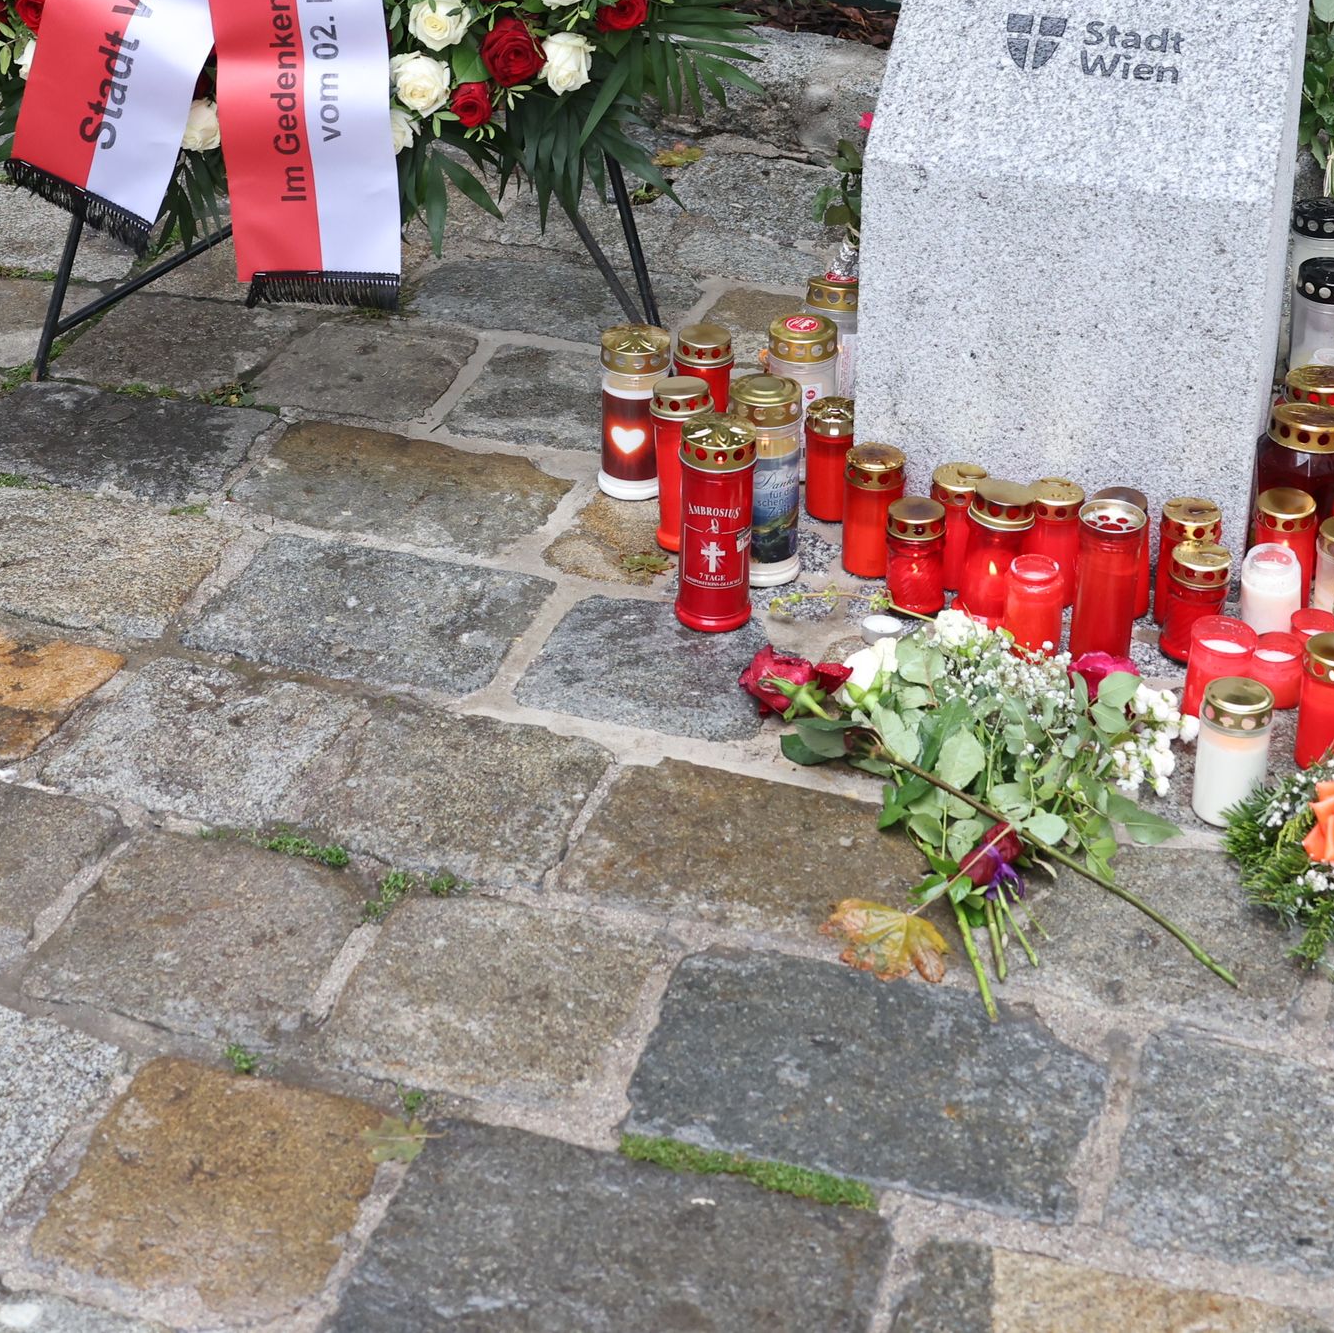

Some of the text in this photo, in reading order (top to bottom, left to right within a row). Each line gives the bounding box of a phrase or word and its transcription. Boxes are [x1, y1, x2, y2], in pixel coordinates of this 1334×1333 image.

[310, 16, 339, 60] 02.
[1082, 20, 1185, 55] Stadt
[1080, 49, 1179, 85] Wien
[79, 30, 140, 150] Stadt
[319, 73, 342, 142] vom
[281, 166, 307, 202] Im
[754, 471, 796, 490] Danke
[770, 490, 782, 499] für
[688, 502, 741, 519] AMBROSIUS
[768, 505, 790, 517] Zeit
[704, 573, 726, 581] TAGE
